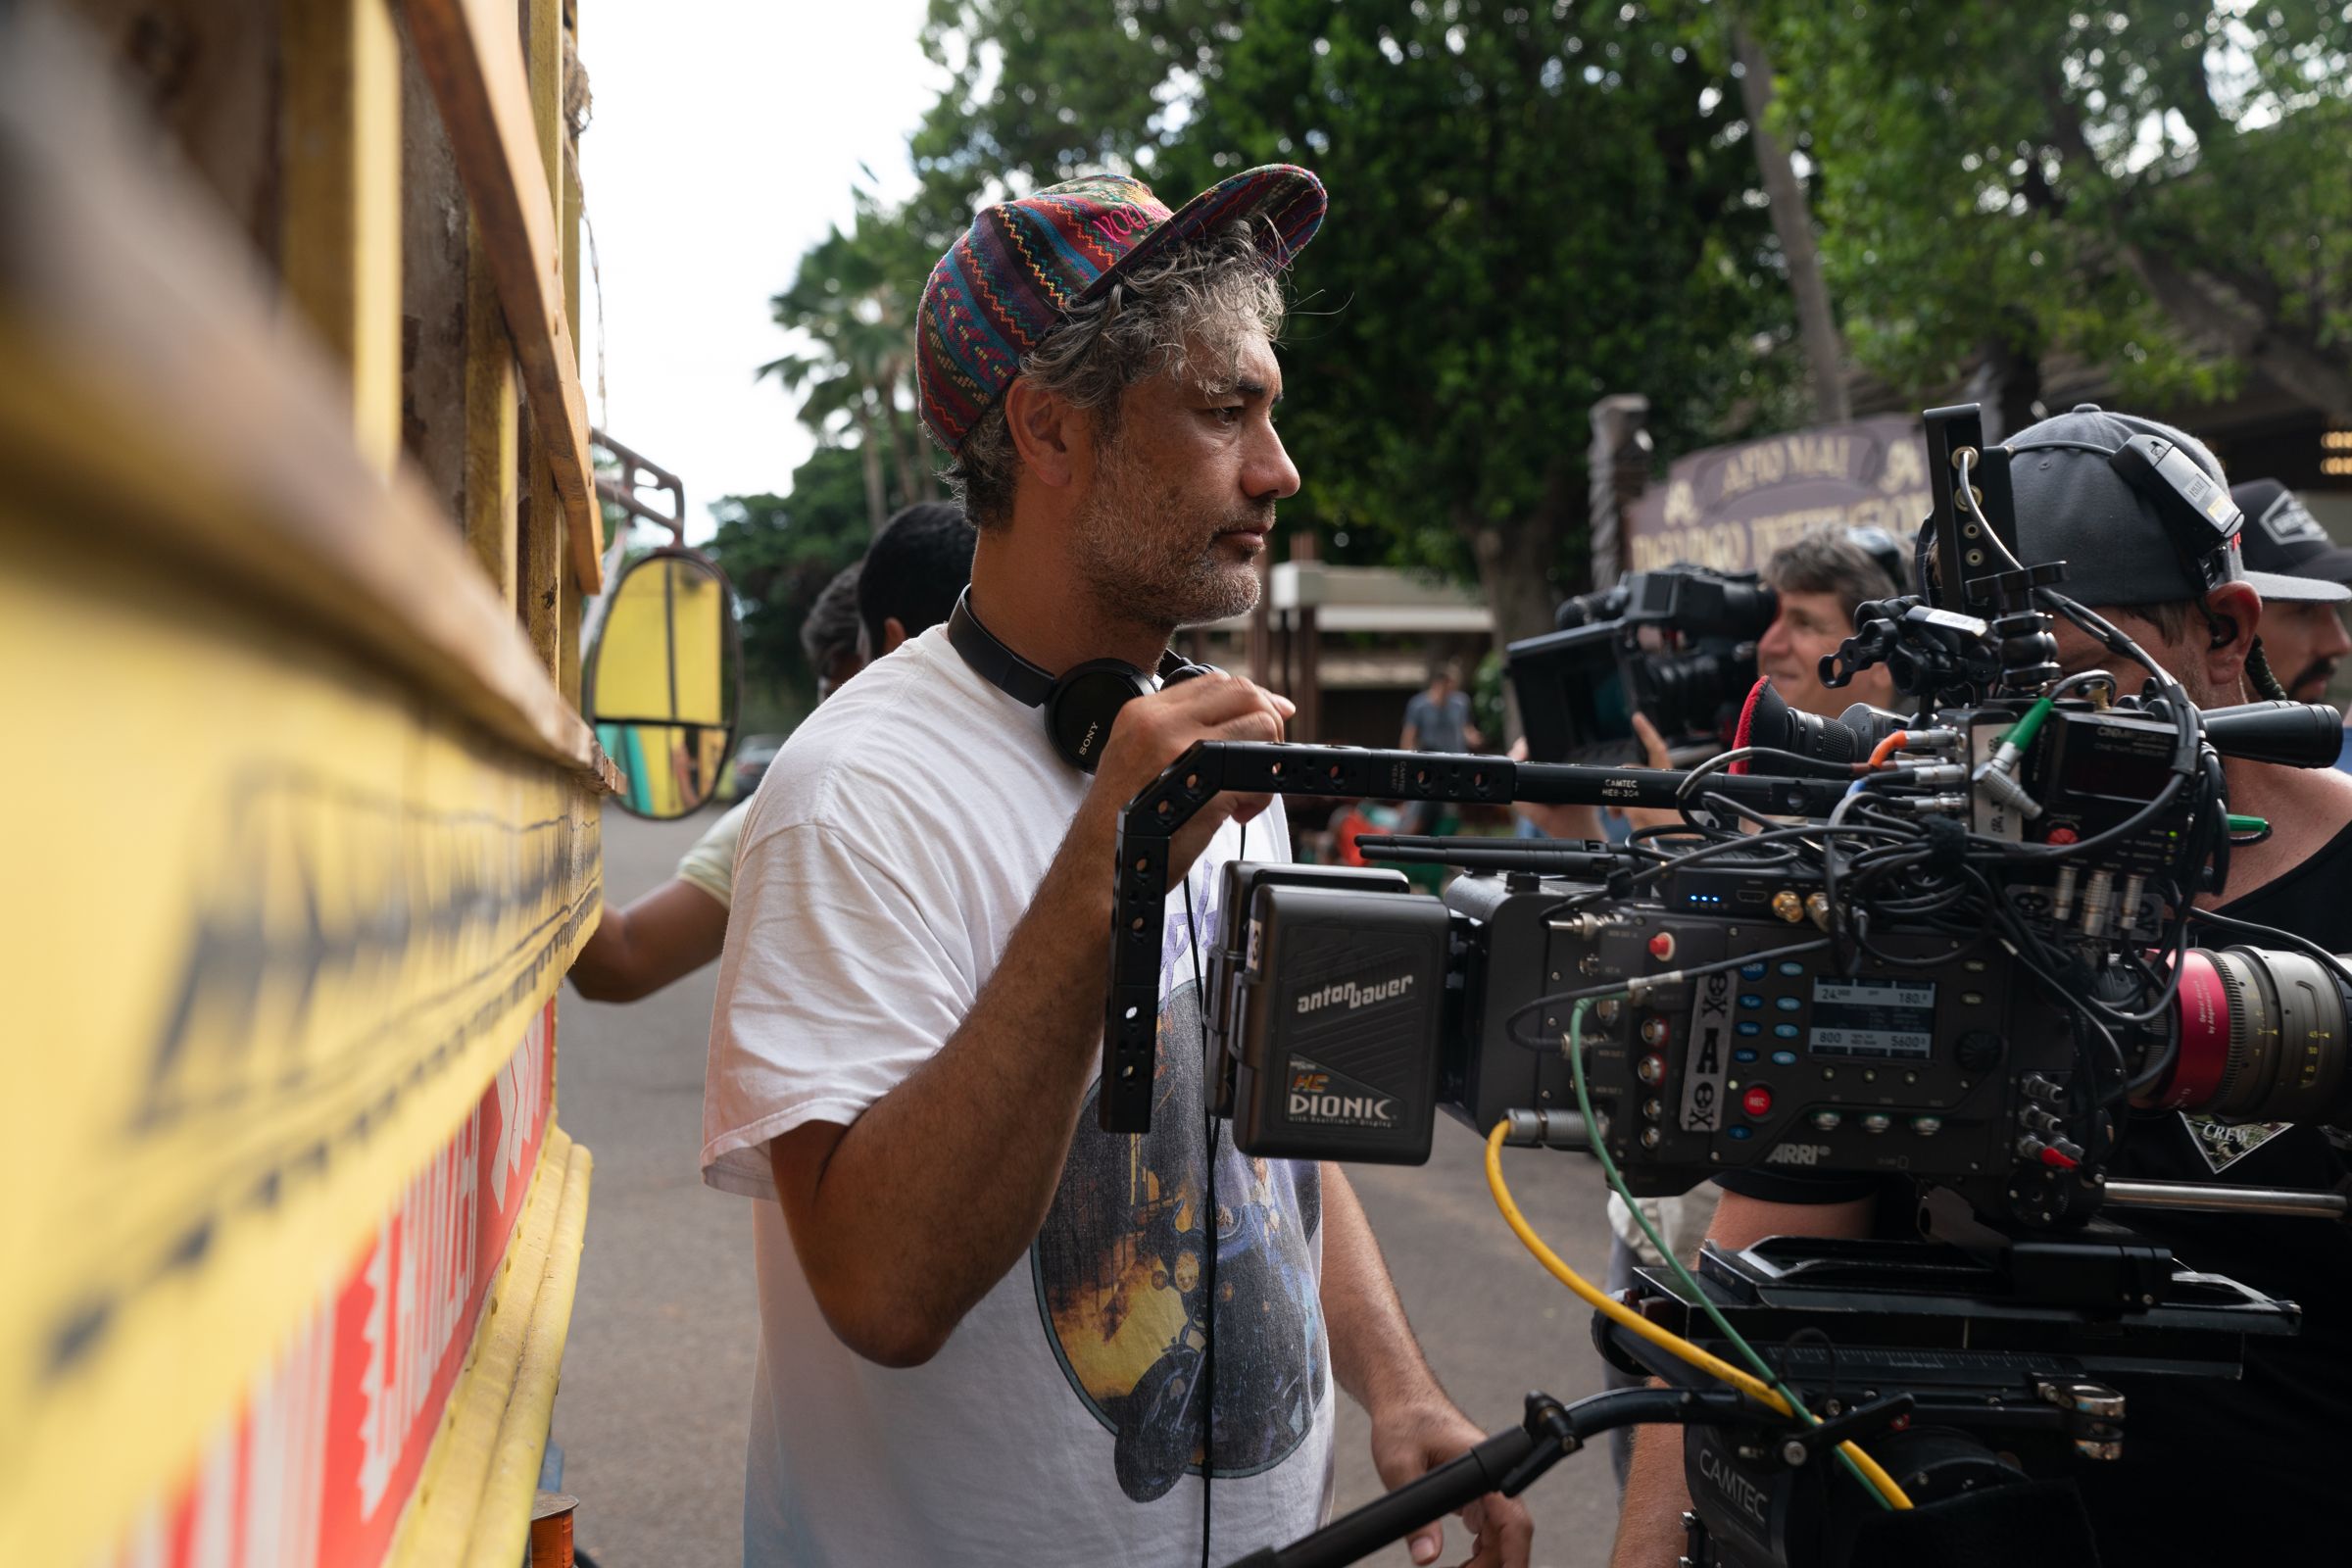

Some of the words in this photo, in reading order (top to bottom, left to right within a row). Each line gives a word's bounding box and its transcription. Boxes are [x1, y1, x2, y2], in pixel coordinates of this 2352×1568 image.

[1078, 721, 1099, 756] SONY
[1604, 778, 1638, 789] CAMTEC
[1819, 1032, 1842, 1044] 800
[1696, 1027, 1719, 1074] A
[1291, 1072, 1331, 1093] HC
[1289, 1094, 1393, 1121] DIONIC
[1748, 1097, 1766, 1106] REC
[2203, 1123, 2251, 1143] CREW
[1765, 1143, 1819, 1165] ARRI
[1699, 1447, 1770, 1524] CAMTEC
